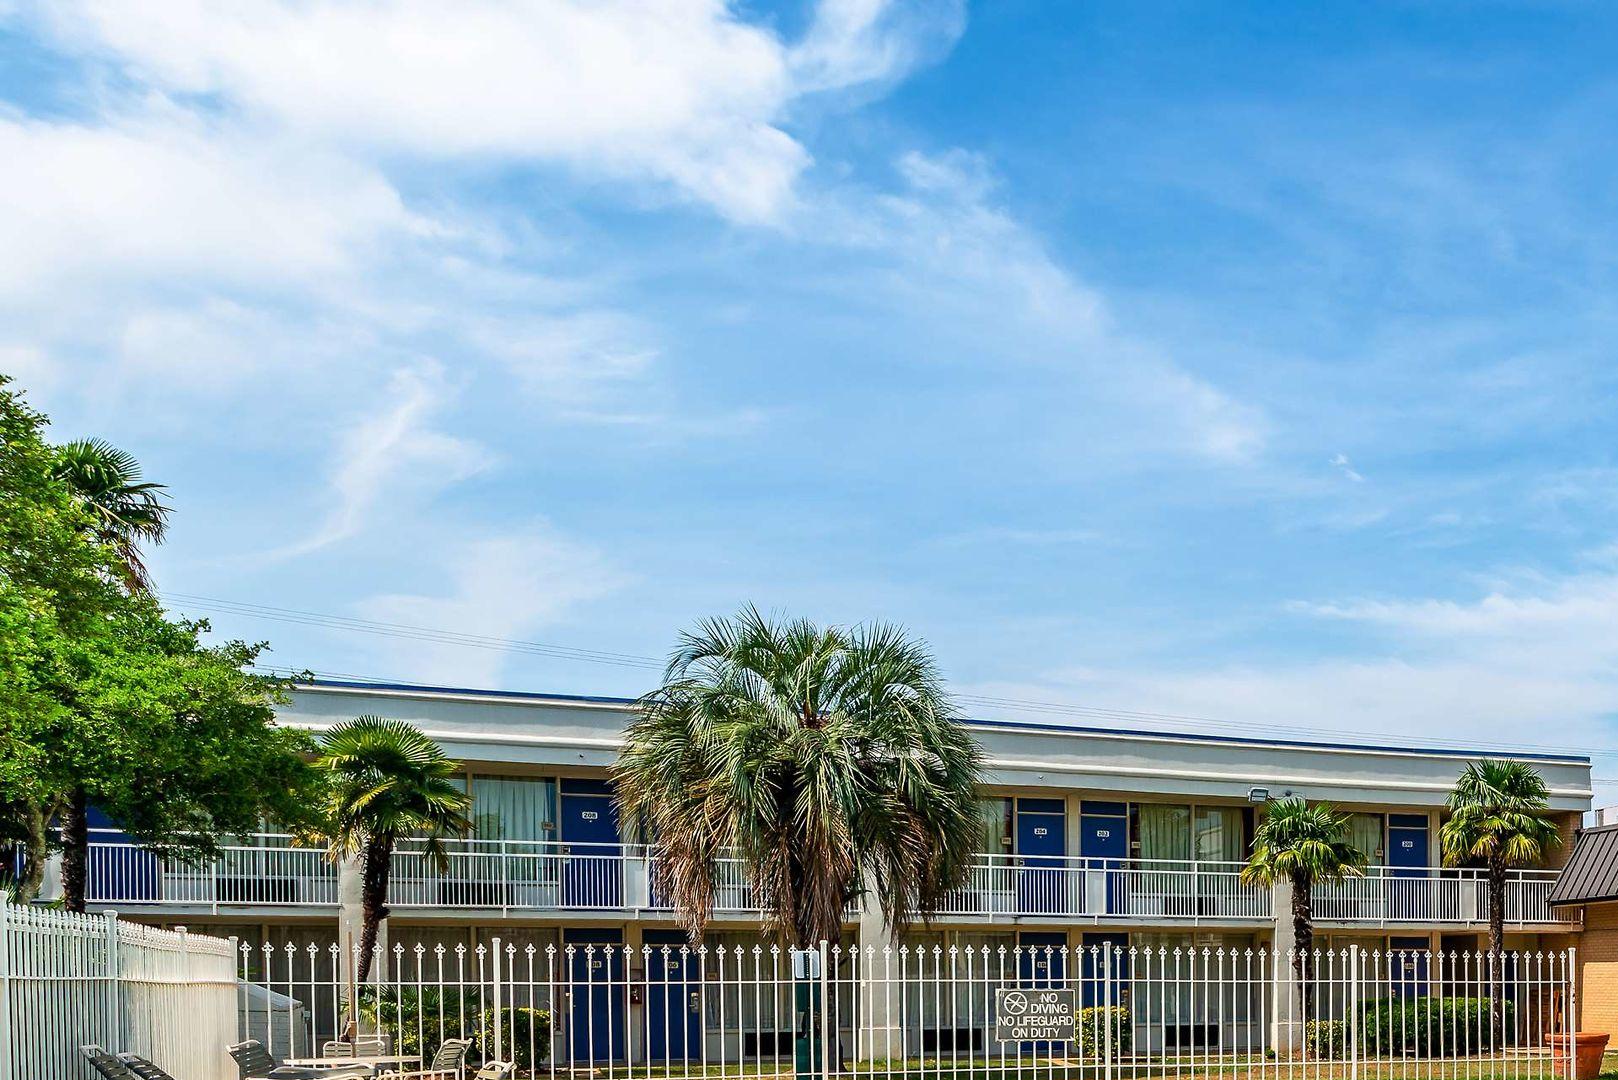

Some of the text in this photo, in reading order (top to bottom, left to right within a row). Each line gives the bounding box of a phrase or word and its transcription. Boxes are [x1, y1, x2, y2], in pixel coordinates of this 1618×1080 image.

[1041, 993, 1058, 1003] NO
[1031, 1004, 1068, 1014] DIVING
[998, 1016, 1073, 1026] NO LIFEGUARD
[1012, 1028, 1060, 1038] ON DUTY
